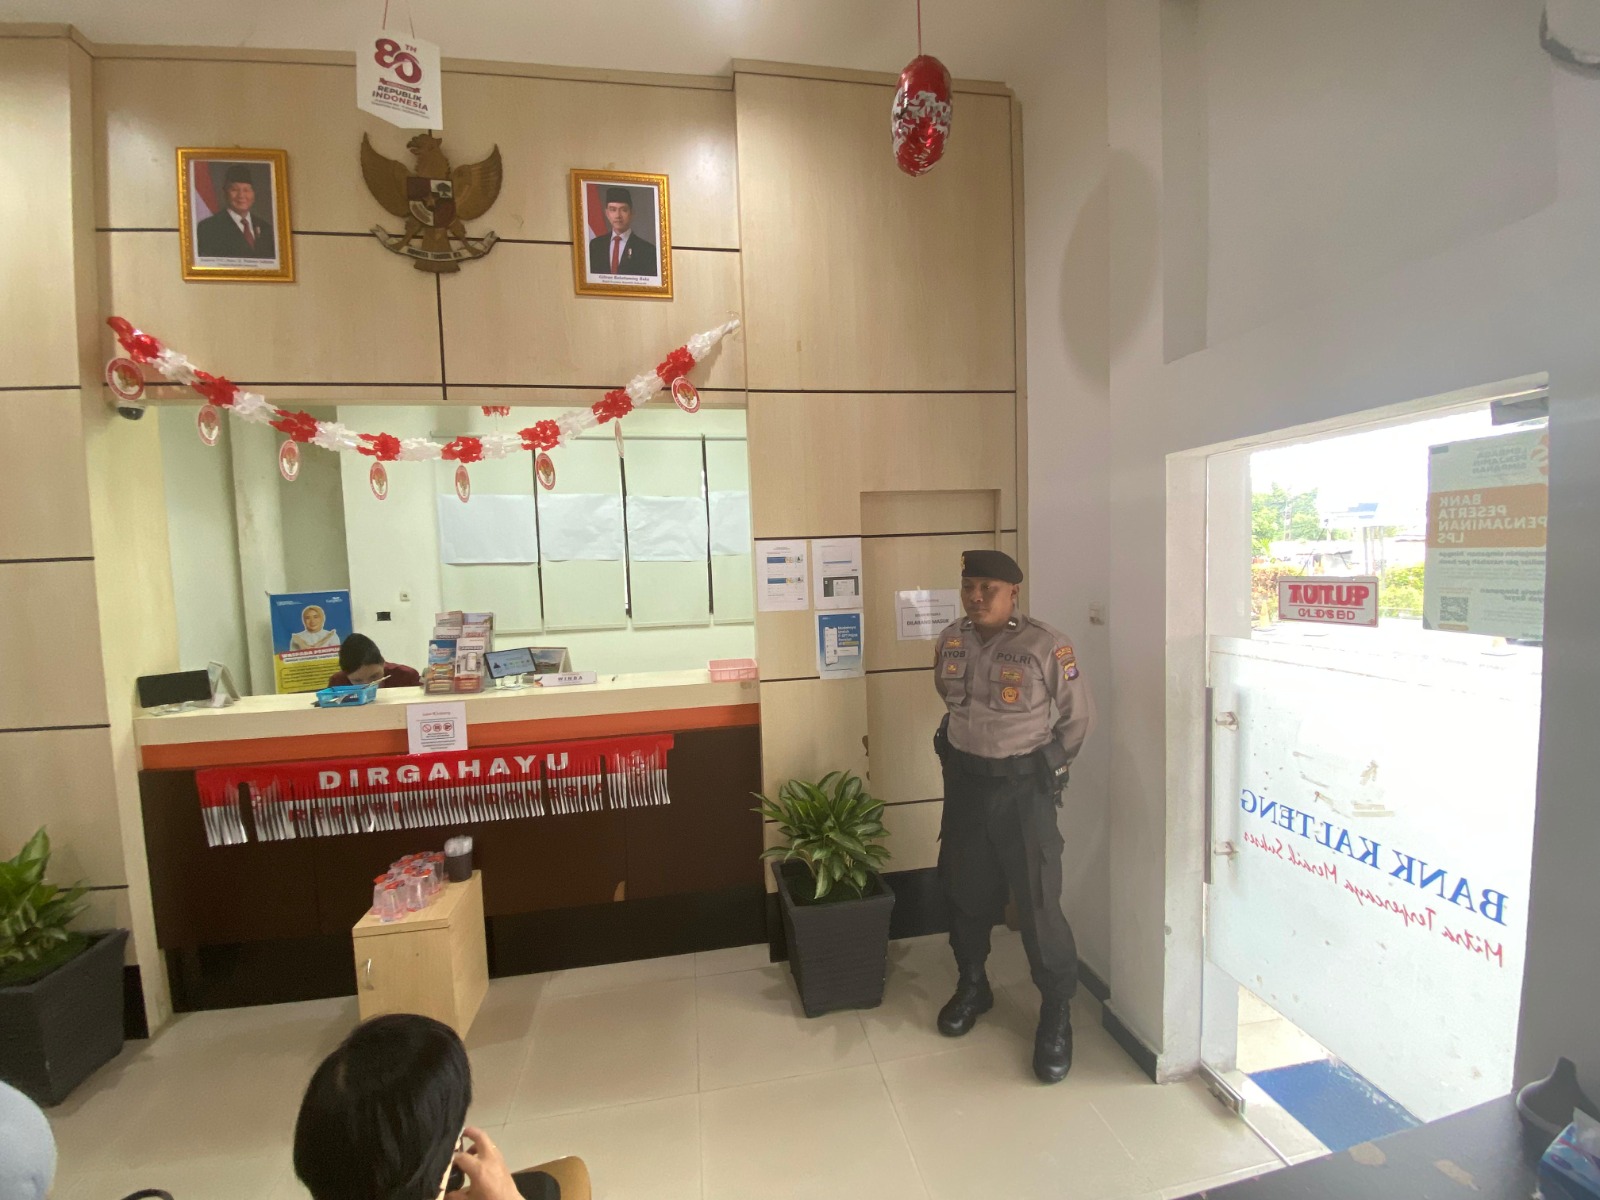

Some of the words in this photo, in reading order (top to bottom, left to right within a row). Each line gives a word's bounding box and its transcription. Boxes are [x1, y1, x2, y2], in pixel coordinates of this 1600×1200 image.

[372, 90, 429, 112] INDONESIA
[377, 85, 422, 102] REPUBLIK
[1288, 584, 1370, 607] TUTUP
[1298, 607, 1356, 621] CLOSED
[943, 650, 966, 658] AYOB
[996, 652, 1032, 664] POLRI
[318, 752, 569, 790] DIRGAHAYU
[451, 782, 603, 809] INDONESIA
